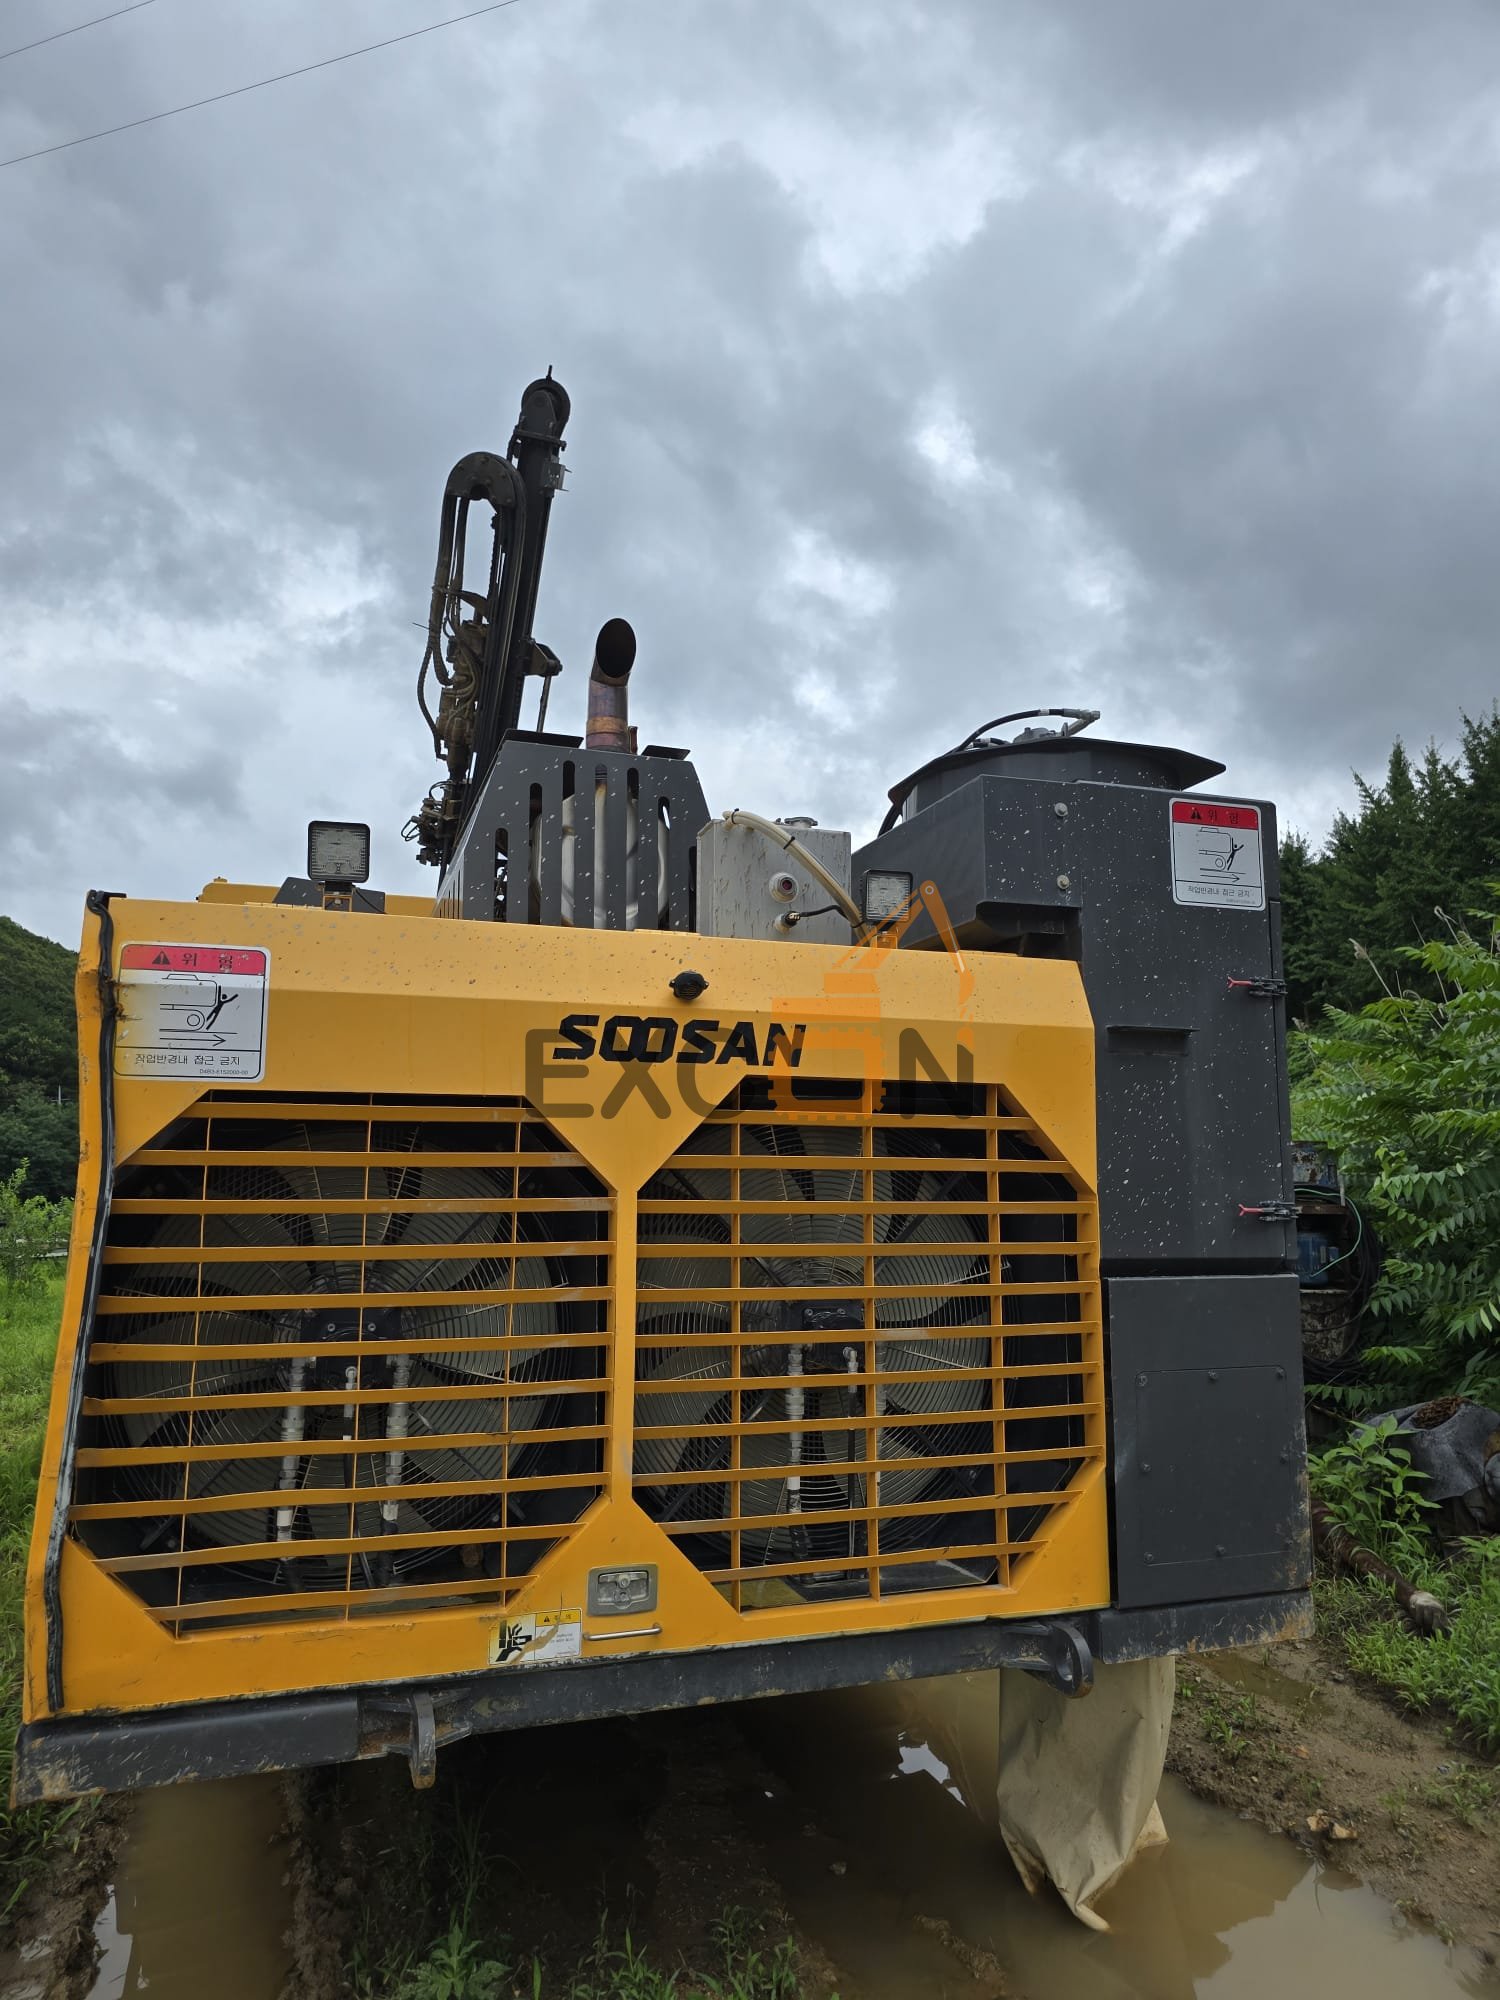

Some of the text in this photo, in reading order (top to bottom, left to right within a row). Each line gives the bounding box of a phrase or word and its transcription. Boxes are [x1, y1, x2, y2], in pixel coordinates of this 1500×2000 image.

[552, 1014, 806, 1067] SOOSAN
[135, 1053, 240, 1066] 작업반경내 접근 금지
